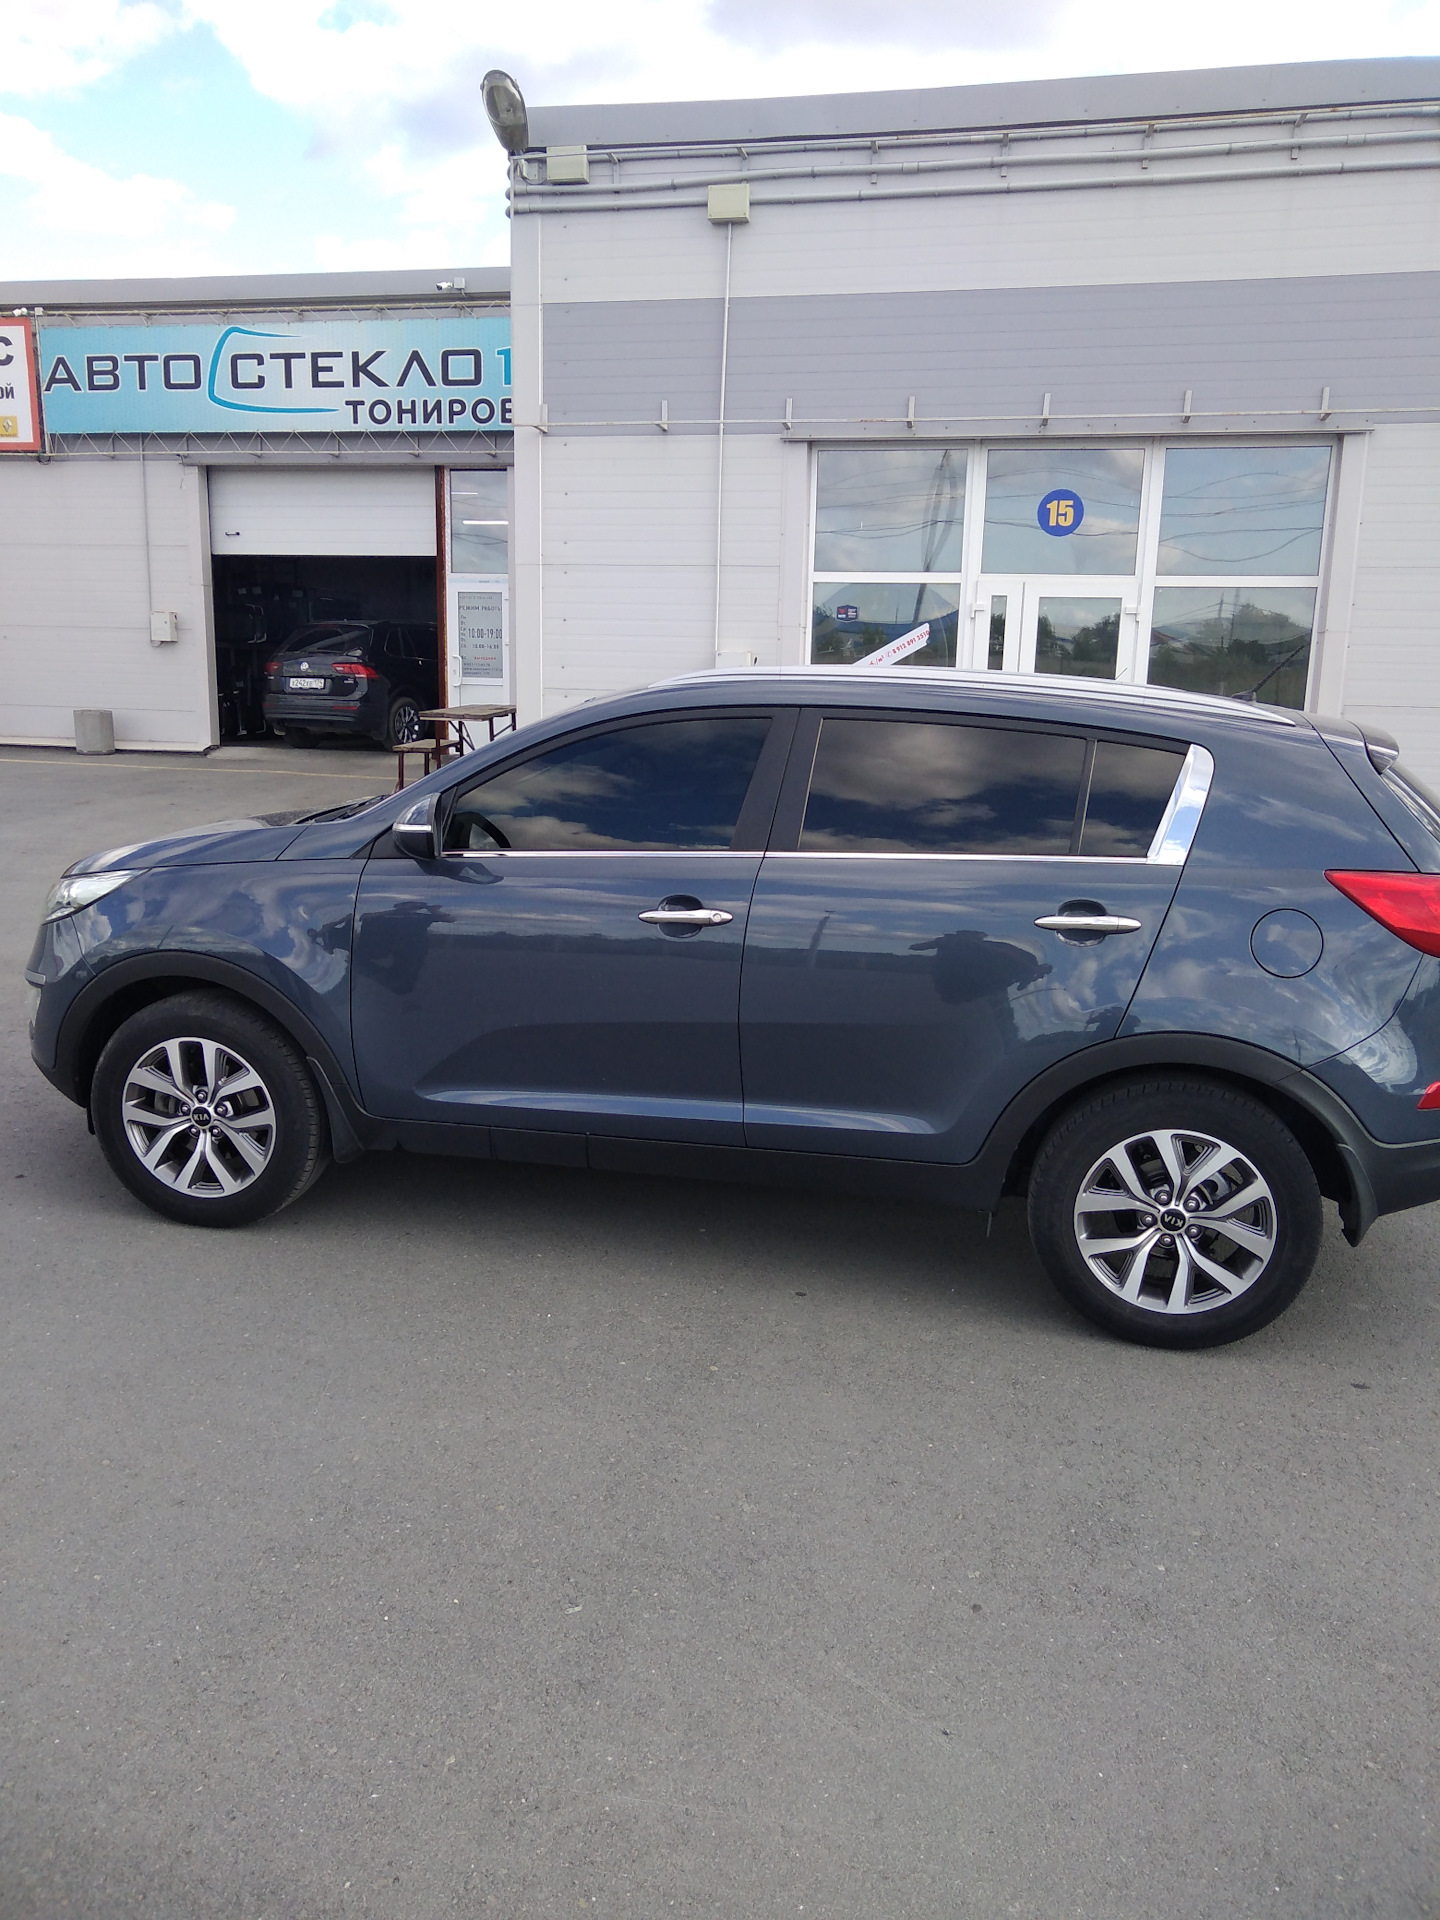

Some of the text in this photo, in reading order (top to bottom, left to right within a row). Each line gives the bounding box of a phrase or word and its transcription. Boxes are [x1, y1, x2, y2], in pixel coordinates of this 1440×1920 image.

[1046, 500, 1075, 526] 15
[193, 1113, 210, 1121] KIA
[1164, 1213, 1184, 1228] KIA
